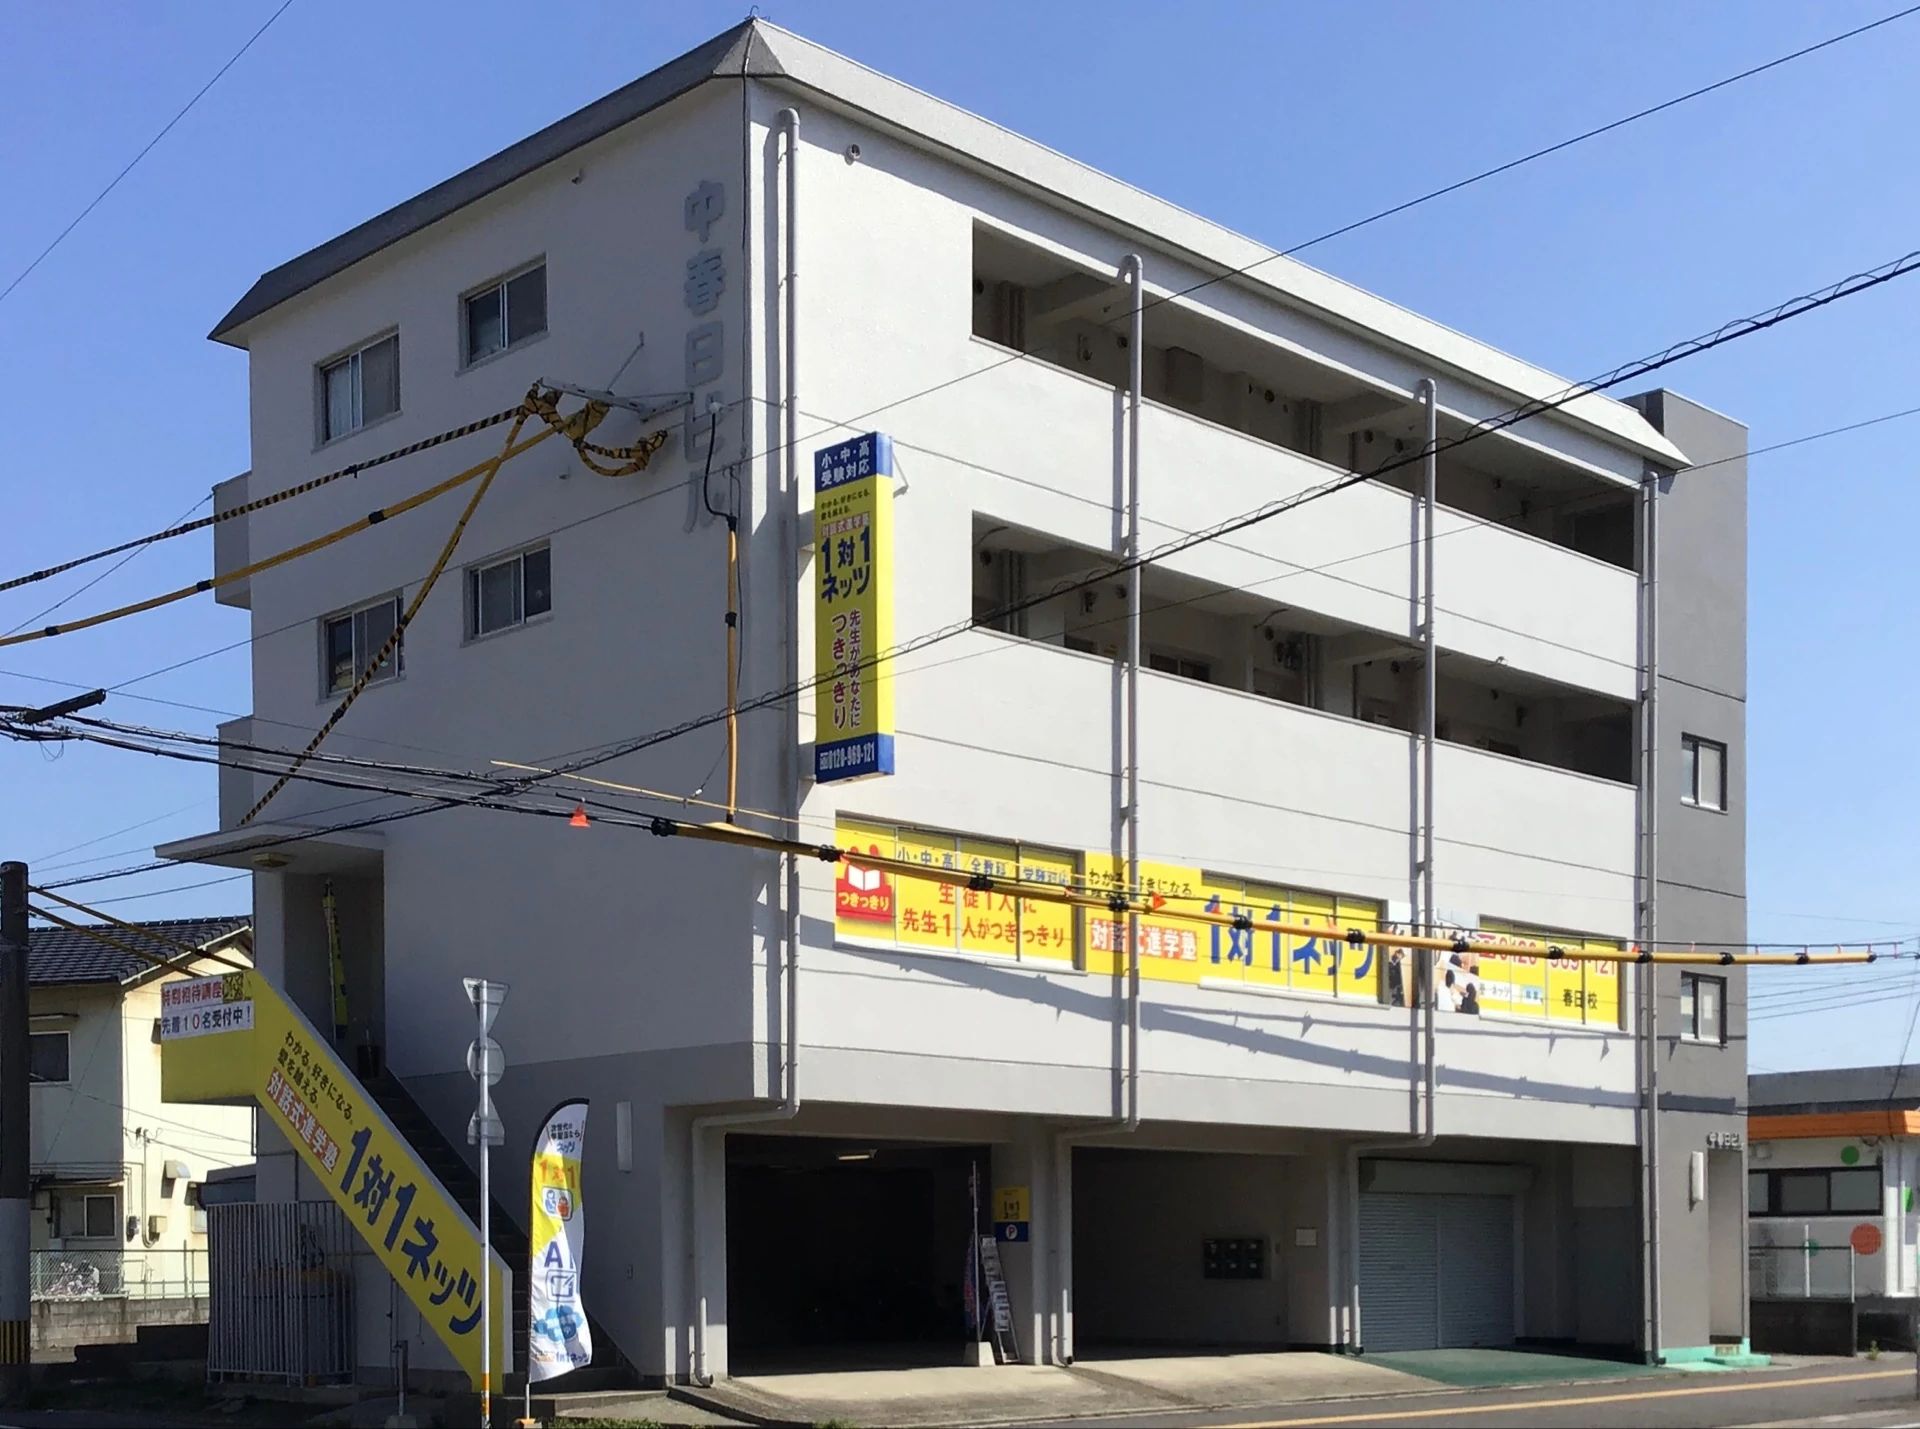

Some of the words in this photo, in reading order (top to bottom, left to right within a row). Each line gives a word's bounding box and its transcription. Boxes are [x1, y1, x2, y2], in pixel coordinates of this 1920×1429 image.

[821, 440, 870, 469] 小・中・高
[821, 458, 870, 488] 受験対応
[821, 526, 870, 574] 1対1
[821, 564, 871, 604] ネッツ
[832, 614, 847, 729] つきっきり
[849, 609, 861, 728] 先生があなたに
[837, 892, 890, 911] つきっきり
[902, 908, 1065, 947] 先生1人がつきっきり
[265, 1070, 340, 1174] 対話式進学塾
[340, 1127, 482, 1335] 1対1ネッツ
